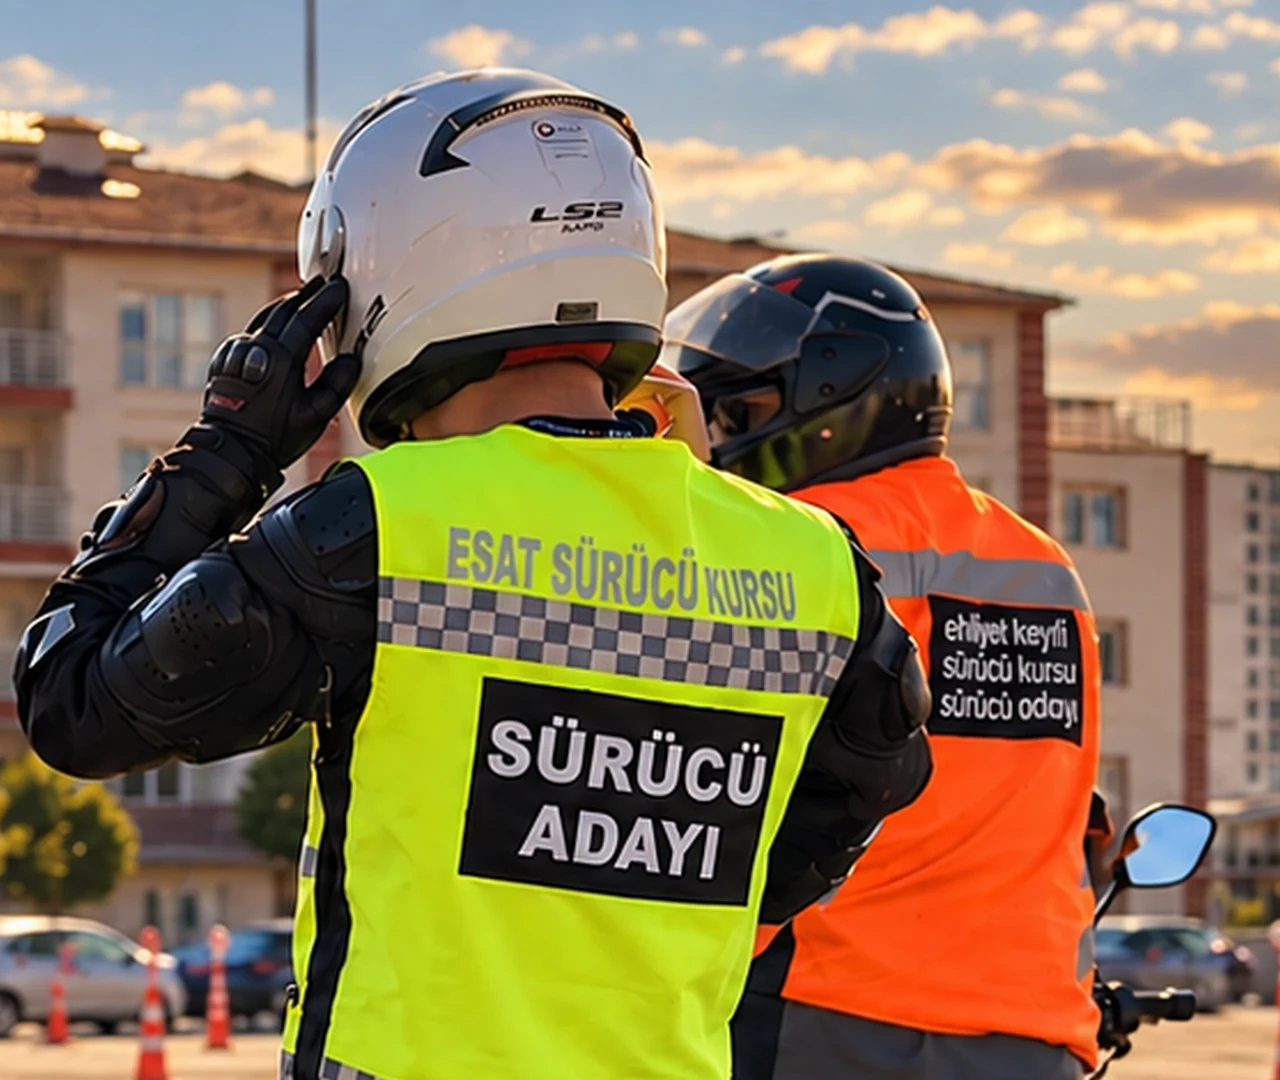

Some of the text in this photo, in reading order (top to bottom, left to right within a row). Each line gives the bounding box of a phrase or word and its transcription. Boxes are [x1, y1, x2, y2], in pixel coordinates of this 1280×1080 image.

[530, 201, 623, 222] LS2
[447, 527, 796, 621] ESAT SÜRÜCÜ KURSU
[1017, 654, 1077, 685] kursu
[487, 715, 767, 806] SÜRÜCÜ
[518, 804, 720, 879] ADAYI
